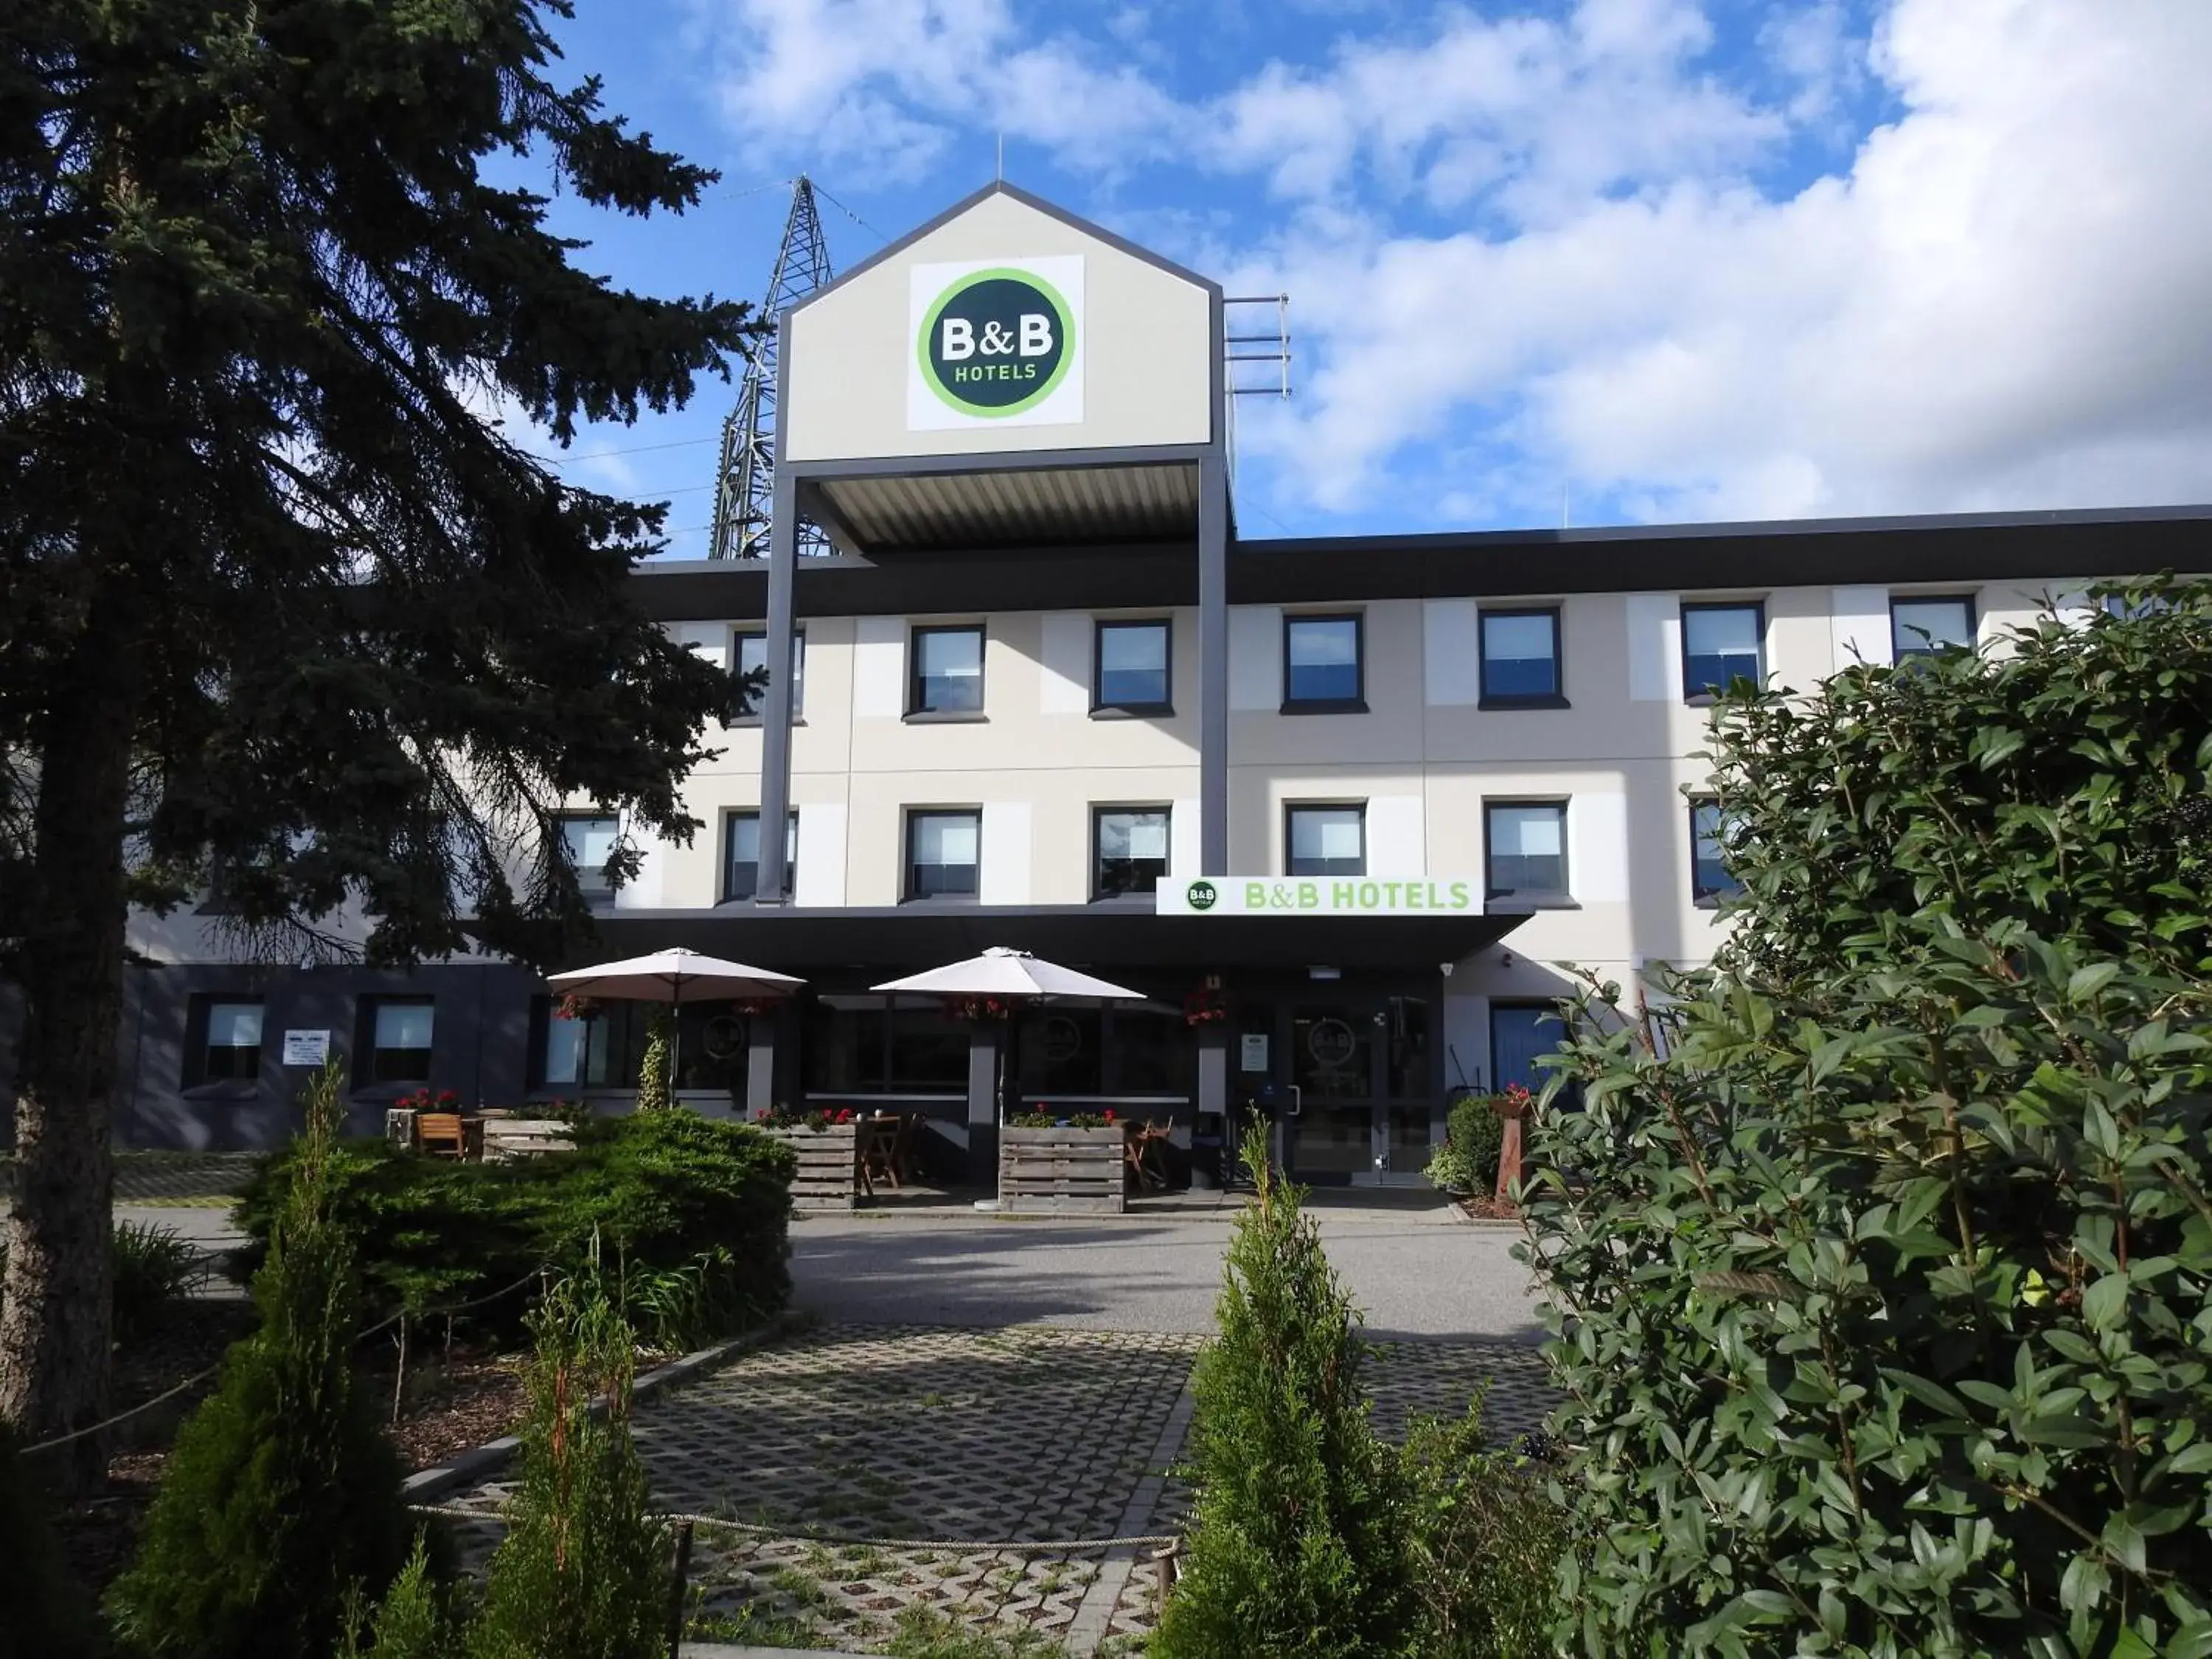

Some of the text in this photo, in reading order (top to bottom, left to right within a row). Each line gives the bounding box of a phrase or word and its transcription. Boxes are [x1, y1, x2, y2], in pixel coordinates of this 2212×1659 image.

[942, 314, 1053, 361] B&B
[955, 364, 1036, 382] HOTELS
[1189, 888, 1214, 900] B&B
[1245, 883, 1470, 909] B&B HOTELS
